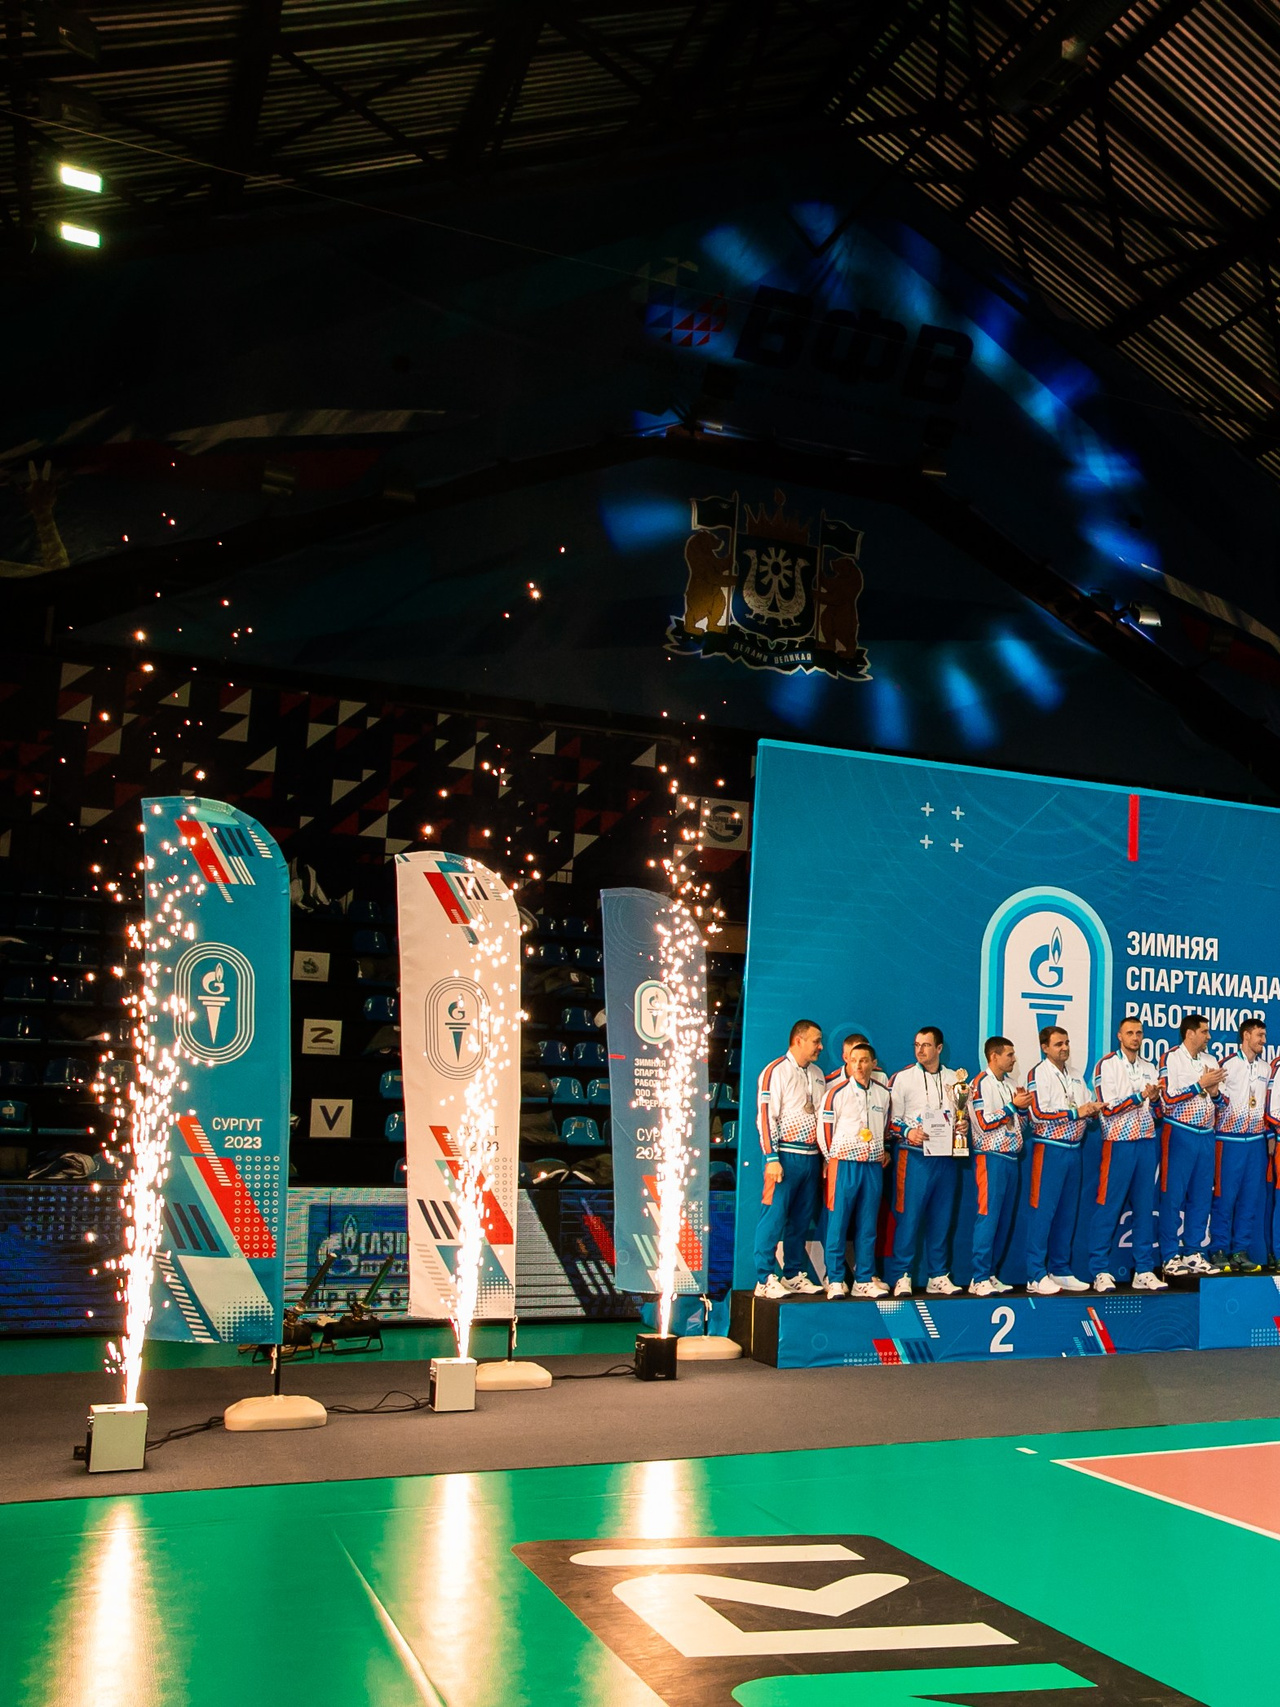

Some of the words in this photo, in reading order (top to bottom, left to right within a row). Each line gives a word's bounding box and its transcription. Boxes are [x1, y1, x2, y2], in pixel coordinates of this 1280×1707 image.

[1127, 931, 1219, 961] ЗИМНЯЯ
[310, 1027, 335, 1044] Z
[1140, 1038, 1170, 1062] ОО
[212, 1117, 263, 1131] СУРГУТ
[320, 1106, 344, 1131] V
[224, 1136, 262, 1149] 2023
[470, 1142, 500, 1151] 223
[636, 1146, 665, 1160] 202
[989, 1305, 1016, 1353] 2
